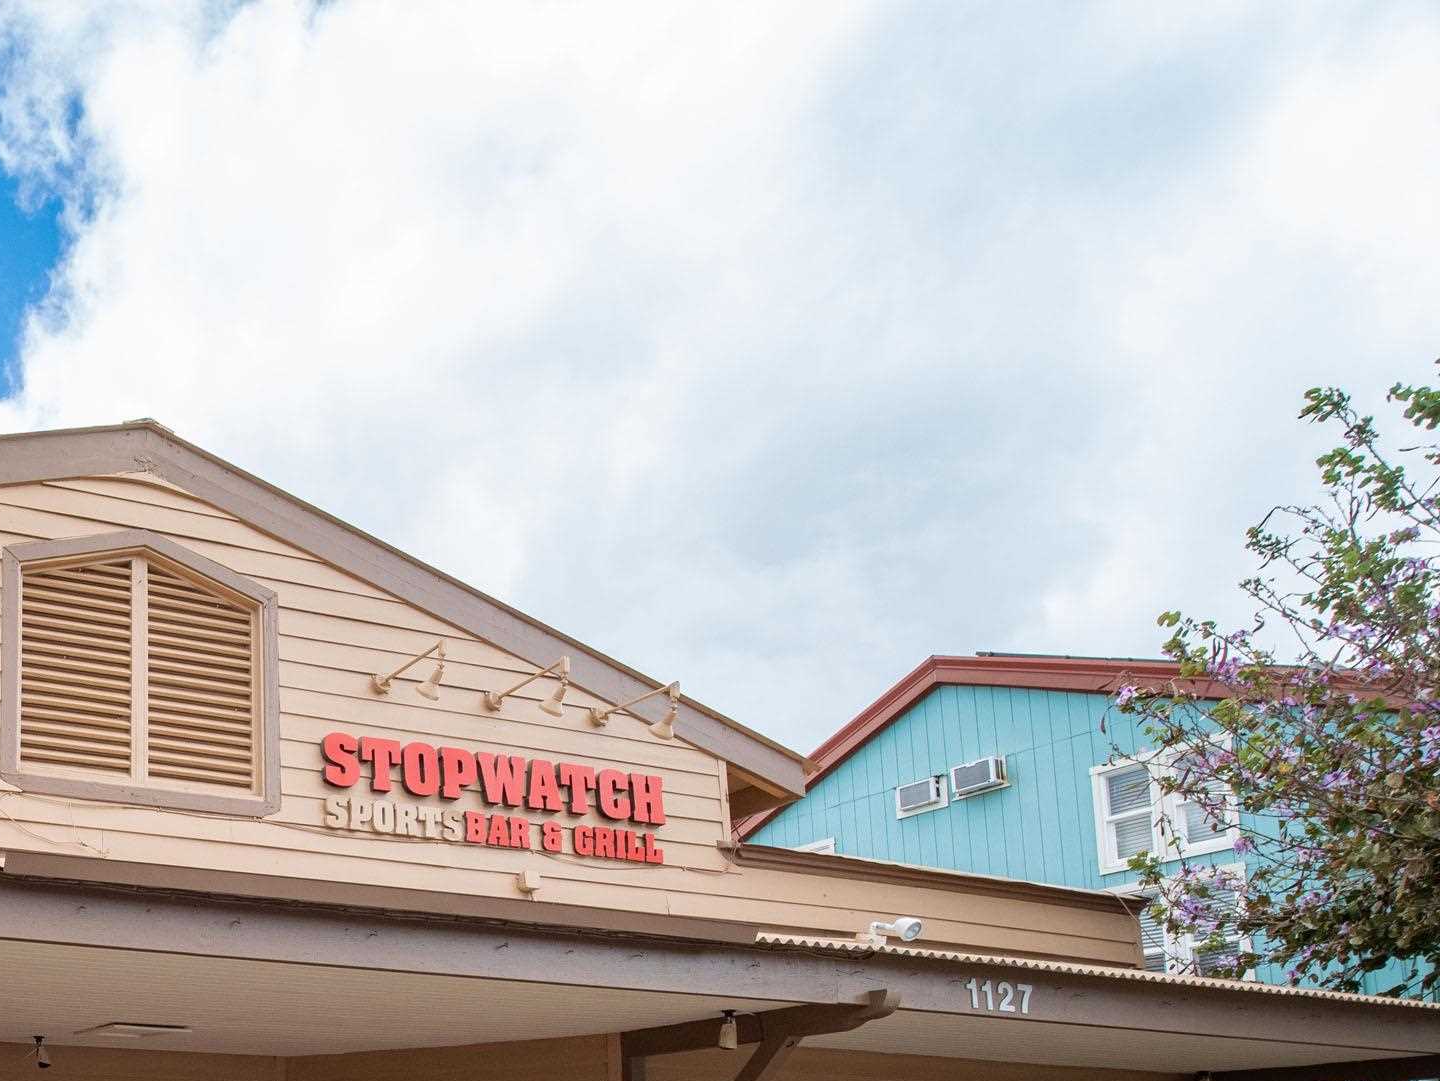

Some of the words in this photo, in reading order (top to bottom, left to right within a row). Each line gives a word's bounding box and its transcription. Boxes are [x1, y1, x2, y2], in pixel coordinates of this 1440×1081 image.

[321, 732, 665, 826] STOPWATCH
[324, 799, 461, 842] SPORTS
[464, 811, 531, 850] BAR
[542, 821, 563, 853] &
[573, 825, 664, 865] GRILL
[965, 977, 1033, 1014] 1127
